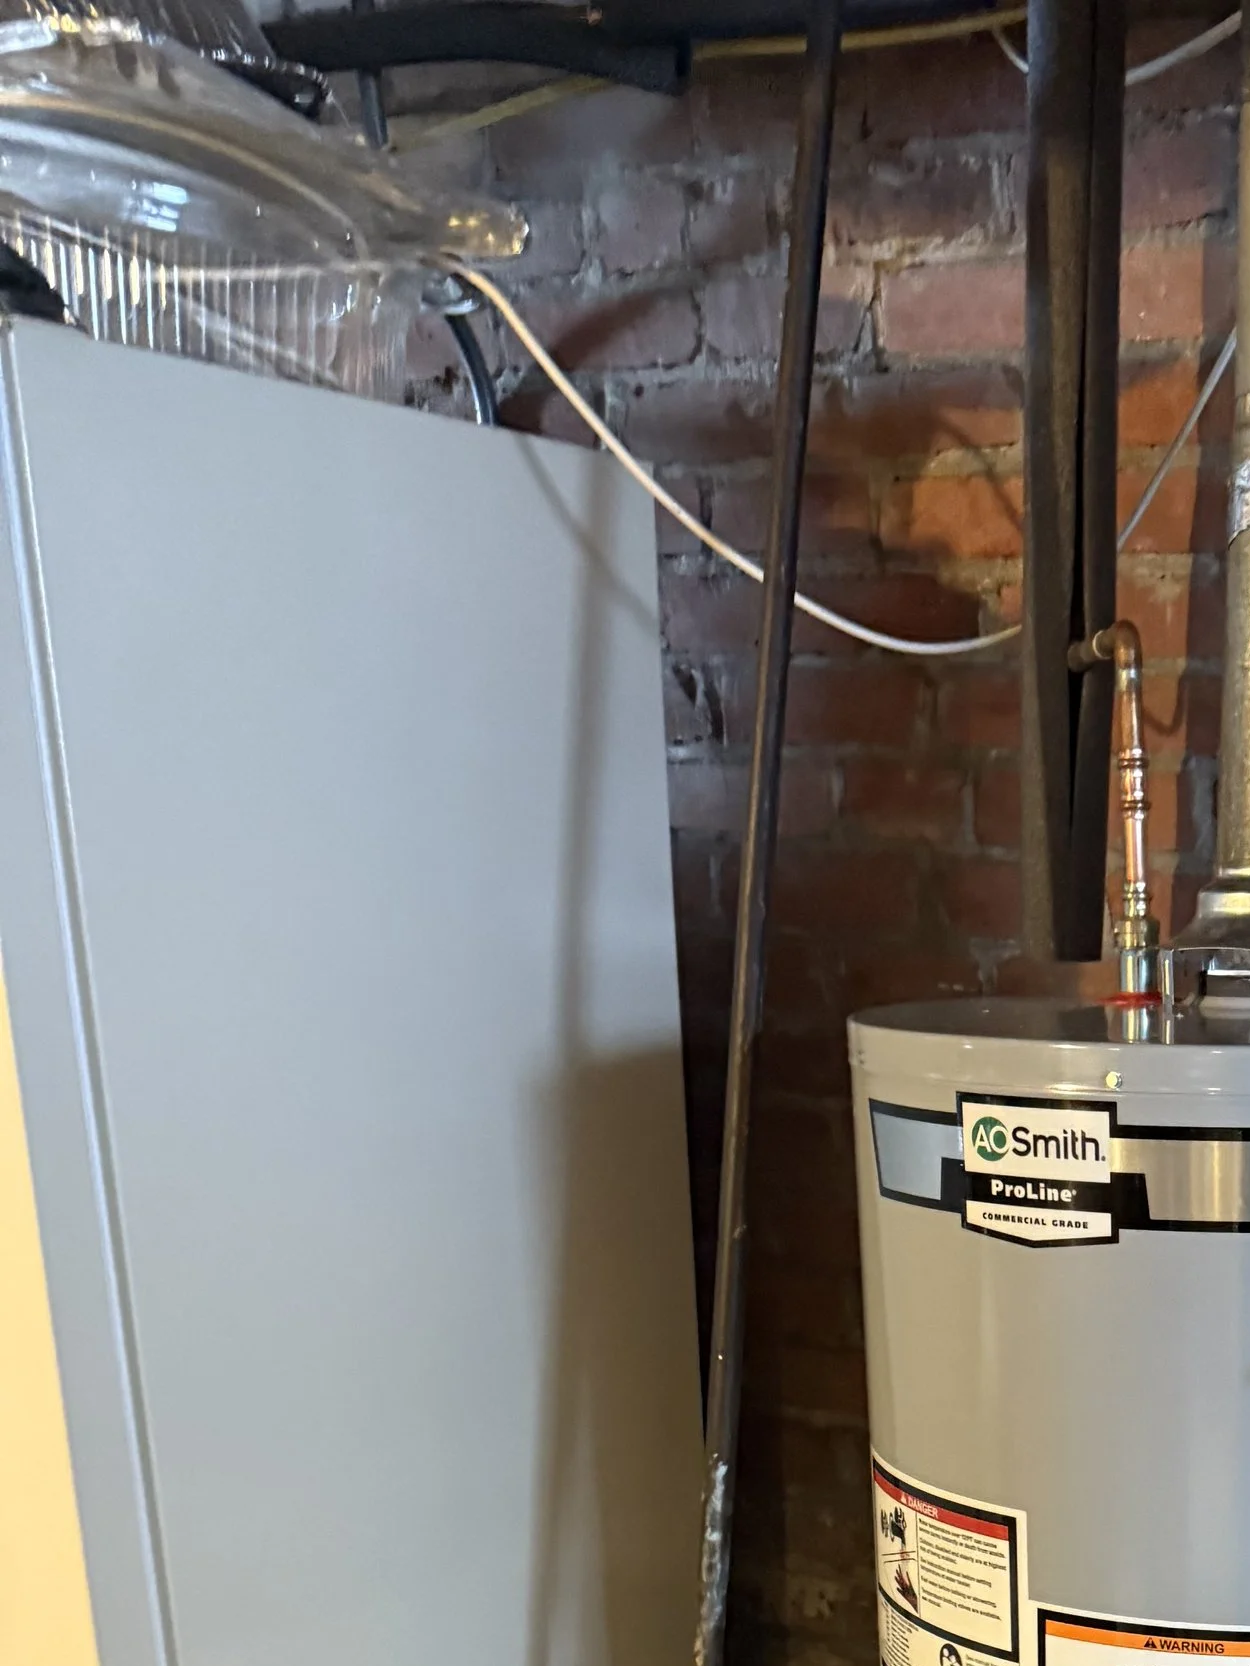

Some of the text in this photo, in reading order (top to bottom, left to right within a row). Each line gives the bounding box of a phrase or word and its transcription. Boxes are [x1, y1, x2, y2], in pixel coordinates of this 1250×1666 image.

[982, 1211, 1089, 1230] COMMERCIAL GRADE
[908, 1496, 938, 1519] DANGER
[1159, 1639, 1225, 1654] WARNING
